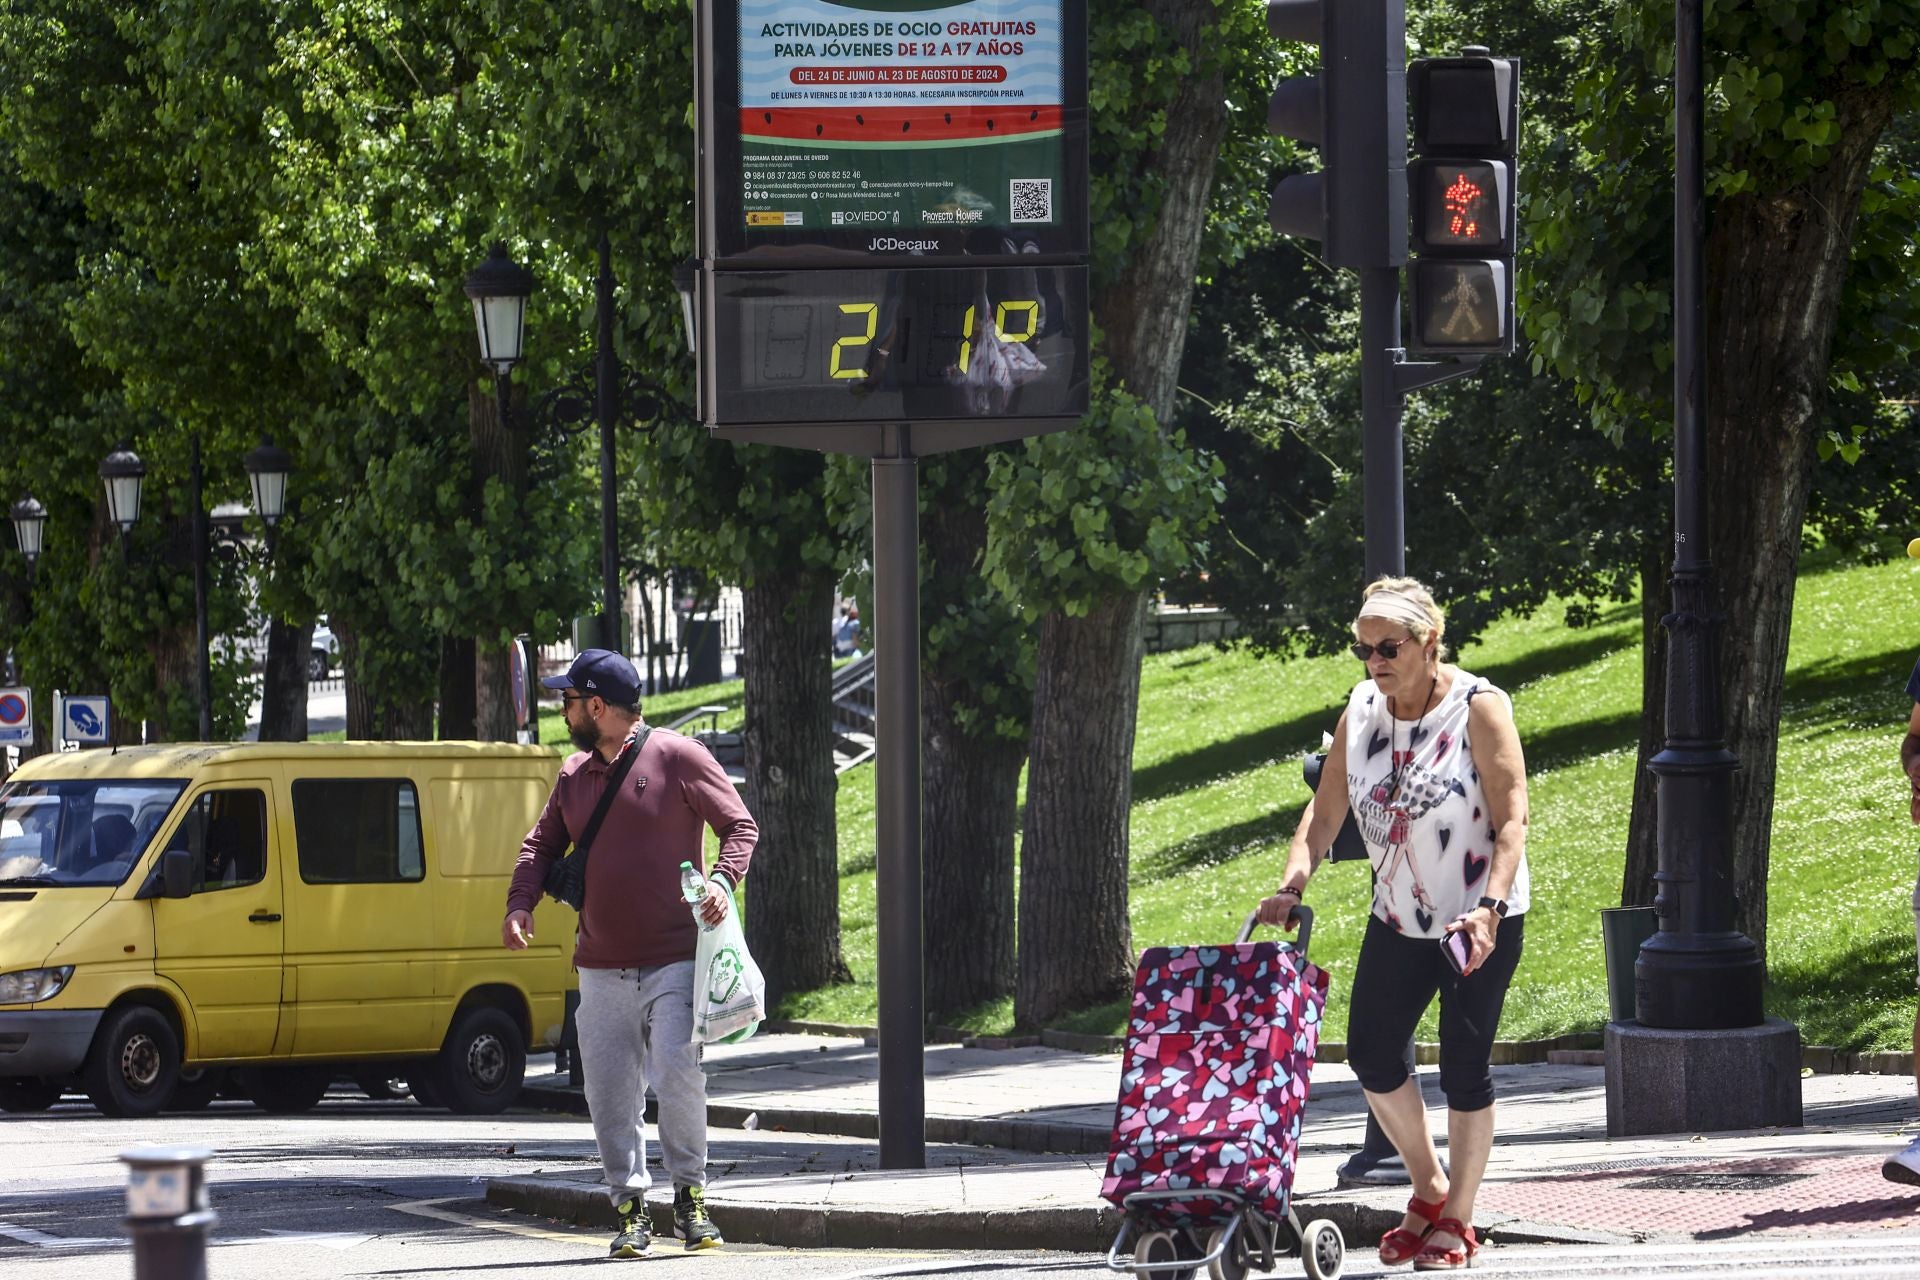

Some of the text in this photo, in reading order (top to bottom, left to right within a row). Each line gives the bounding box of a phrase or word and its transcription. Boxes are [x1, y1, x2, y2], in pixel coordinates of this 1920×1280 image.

[761, 21, 1036, 37] ACTIVIDADES DE OCIO GRATUITAS
[774, 39, 1024, 57] PARA JÓVENES DE 12 A 17 AÑOS
[798, 69, 999, 81] DEL 24 DE JUNIO AL 23 DE AGOSTO DE 2024
[771, 91, 780, 99] DE
[781, 91, 802, 99] LUNES
[804, 91, 809, 99] A
[894, 90, 918, 98] HORAS.
[921, 90, 956, 98] NECESARIA
[958, 88, 999, 98] INSCRIPCIÓN
[752, 170, 861, 180] 984 08 37 23/25 606 82 52 46
[844, 211, 887, 221] OVIEDO
[922, 208, 983, 221] PROYECTO HOMBRE
[868, 237, 939, 251] JCDecaux
